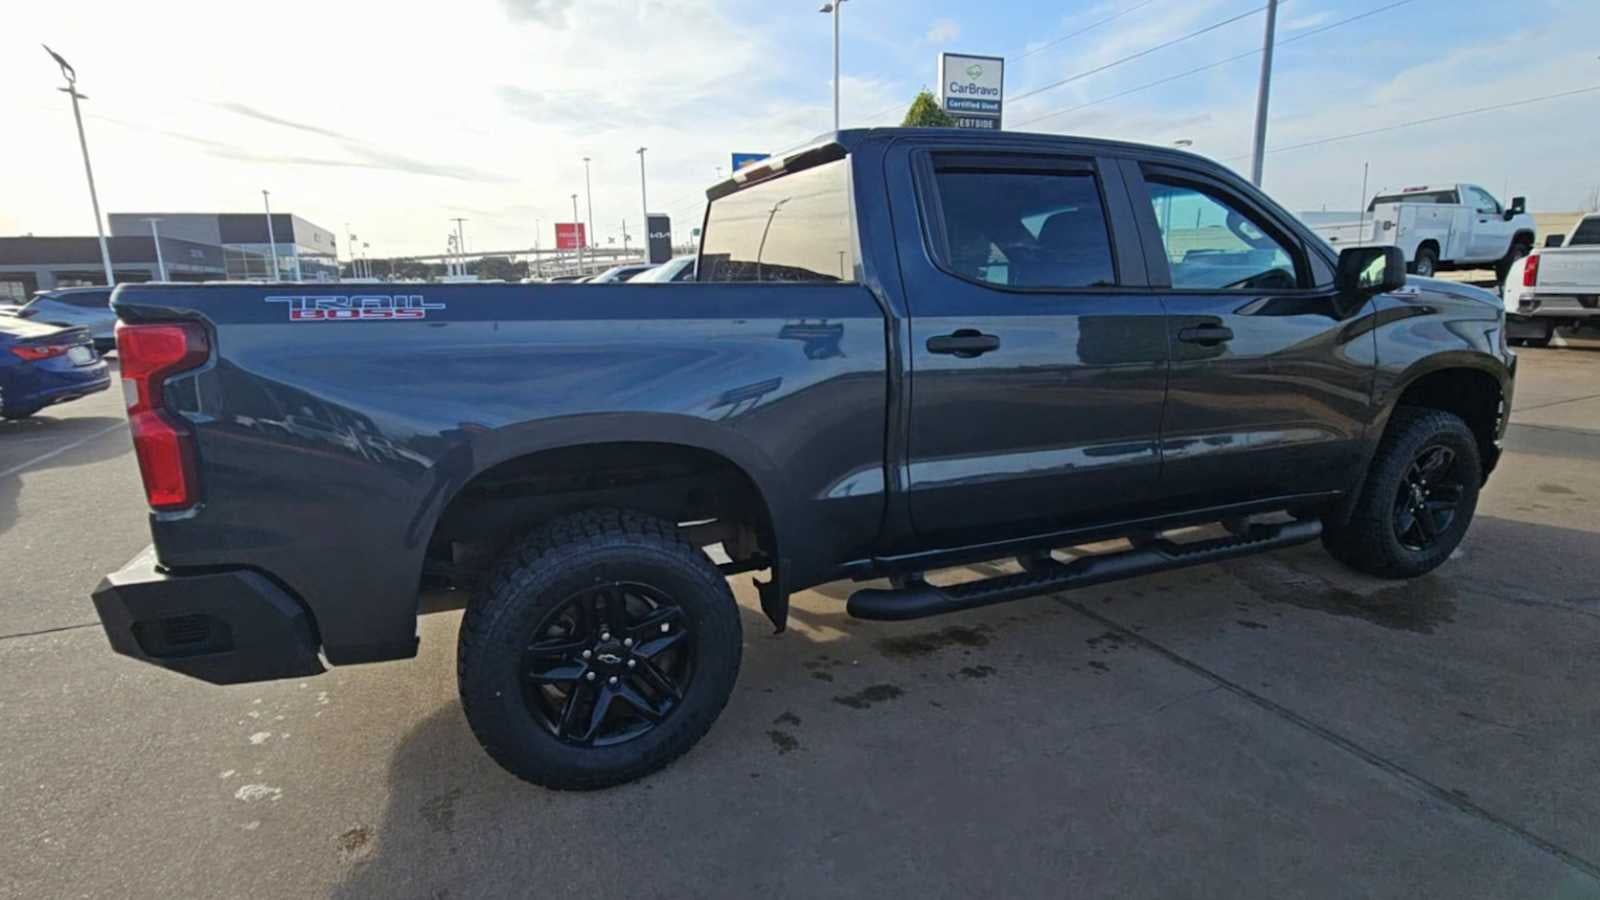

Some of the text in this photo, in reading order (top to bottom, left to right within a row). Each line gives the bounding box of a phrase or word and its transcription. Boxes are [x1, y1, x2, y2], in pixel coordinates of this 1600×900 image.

[950, 82, 998, 96] CarBravo
[264, 295, 446, 310] TRAIL
[289, 309, 426, 321] BOSS
